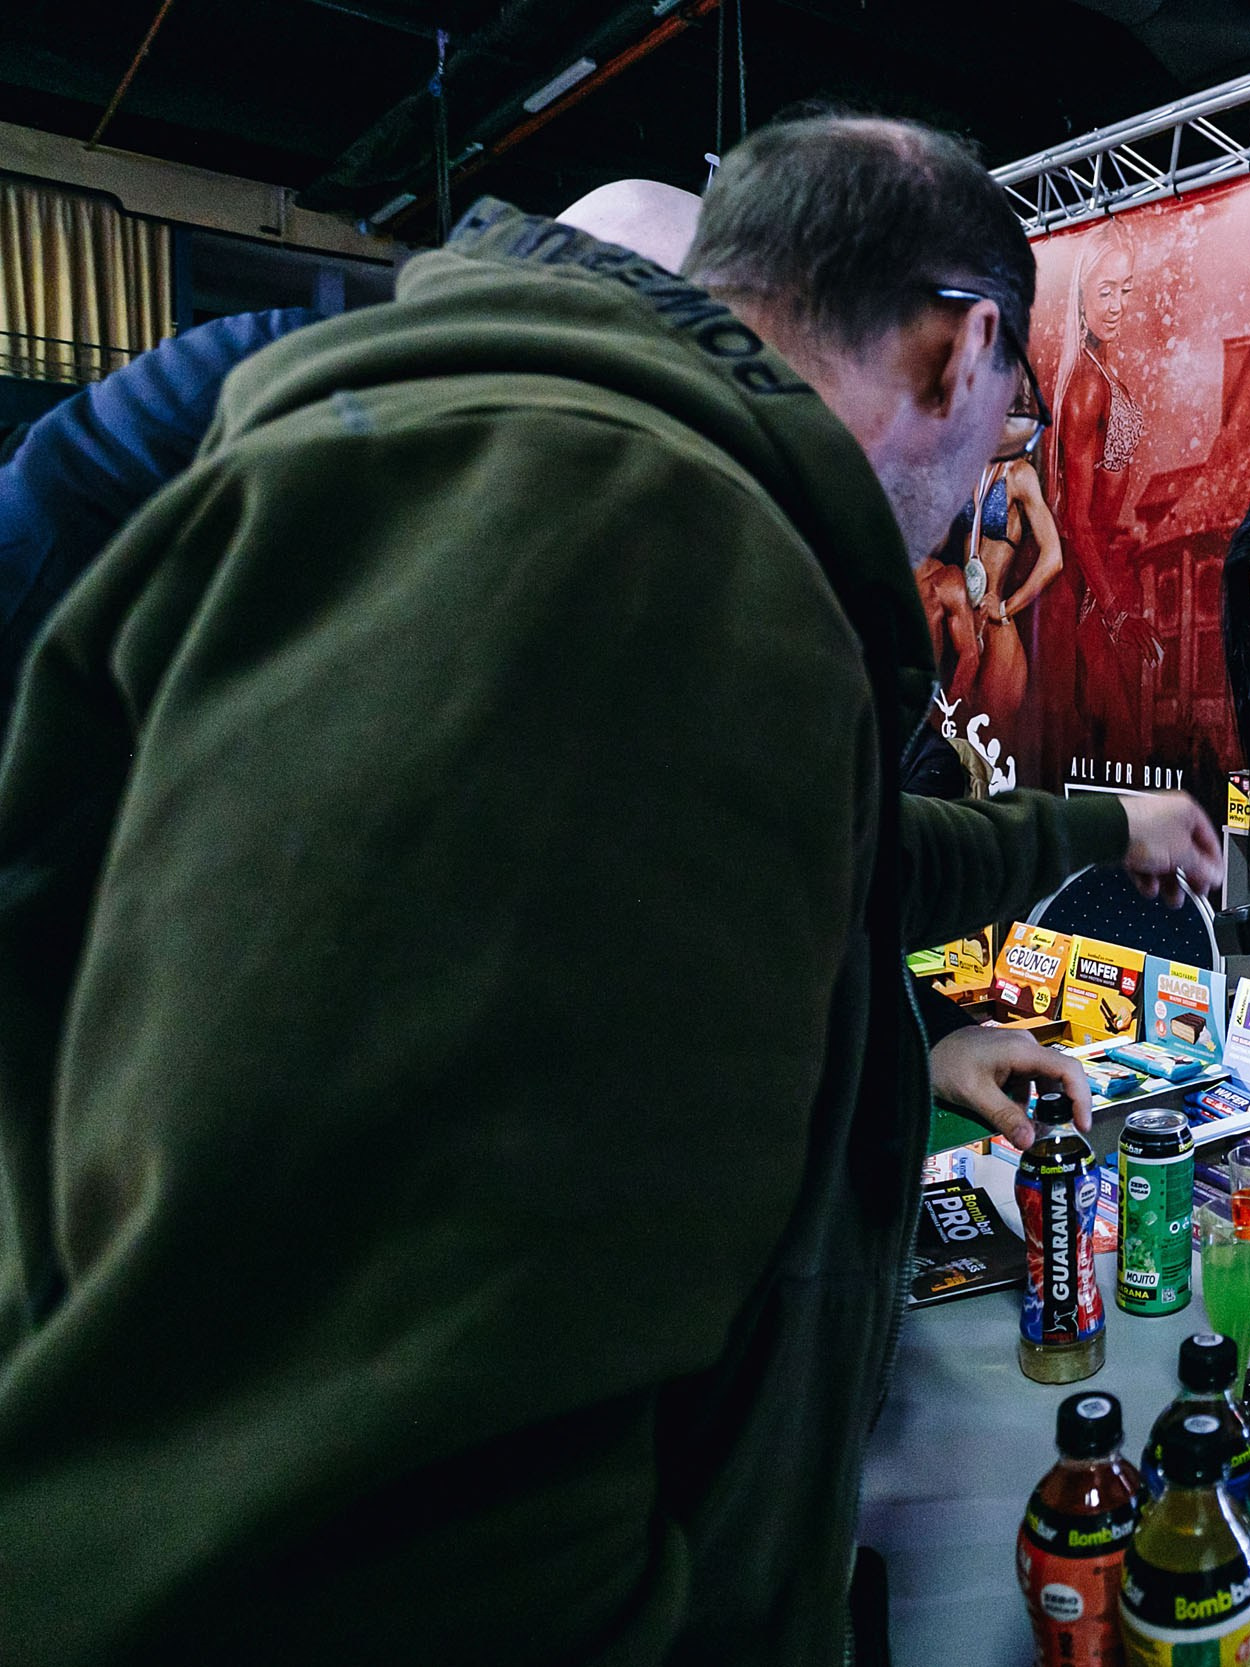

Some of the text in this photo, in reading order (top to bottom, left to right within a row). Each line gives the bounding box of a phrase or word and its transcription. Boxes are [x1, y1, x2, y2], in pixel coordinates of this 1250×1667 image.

[1070, 756, 1183, 791] ALL FOR BODY
[1230, 803, 1250, 815] PRO
[1008, 948, 1060, 977] CRUNCH
[1081, 959, 1118, 981] WAFER
[1036, 992, 1048, 1003] 25%
[1159, 977, 1208, 1003] SNAQFER
[1214, 1087, 1250, 1107] WAFER
[1040, 1162, 1076, 1175] Bombbar
[1081, 1187, 1096, 1199] ZERO
[932, 1196, 979, 1241] PRO
[962, 1194, 995, 1236] Bombbar
[1051, 1186, 1070, 1301] GUARANA
[1080, 1233, 1089, 1267] DRINK
[1126, 1271, 1156, 1285] MOJITO
[1068, 1519, 1134, 1547] Bombbar
